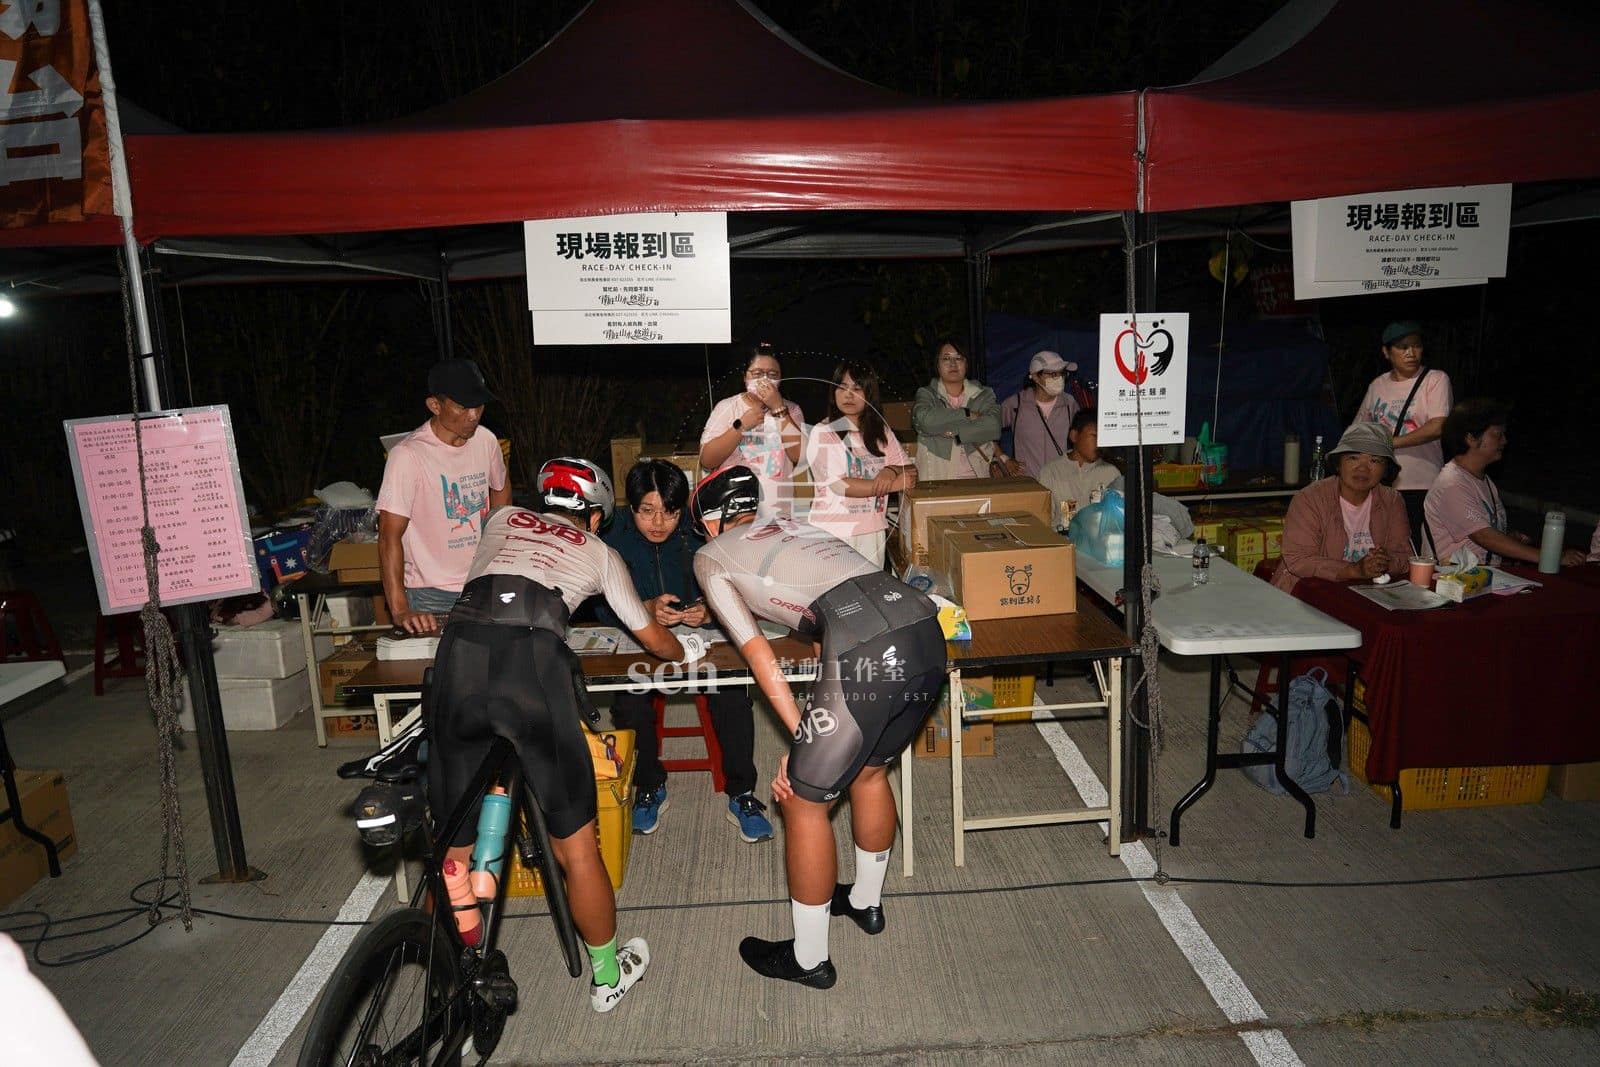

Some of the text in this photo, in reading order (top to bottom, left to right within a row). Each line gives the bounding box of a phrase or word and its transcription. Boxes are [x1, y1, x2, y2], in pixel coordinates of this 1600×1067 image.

[1346, 202, 1480, 231] 現場報到區
[556, 231, 696, 260] 現場報到區
[1368, 233, 1456, 242] RACE-DAY CHECK-IN
[581, 263, 673, 272] RACE-DAY CHECK-IN
[769, 597, 817, 625] ORBEA
